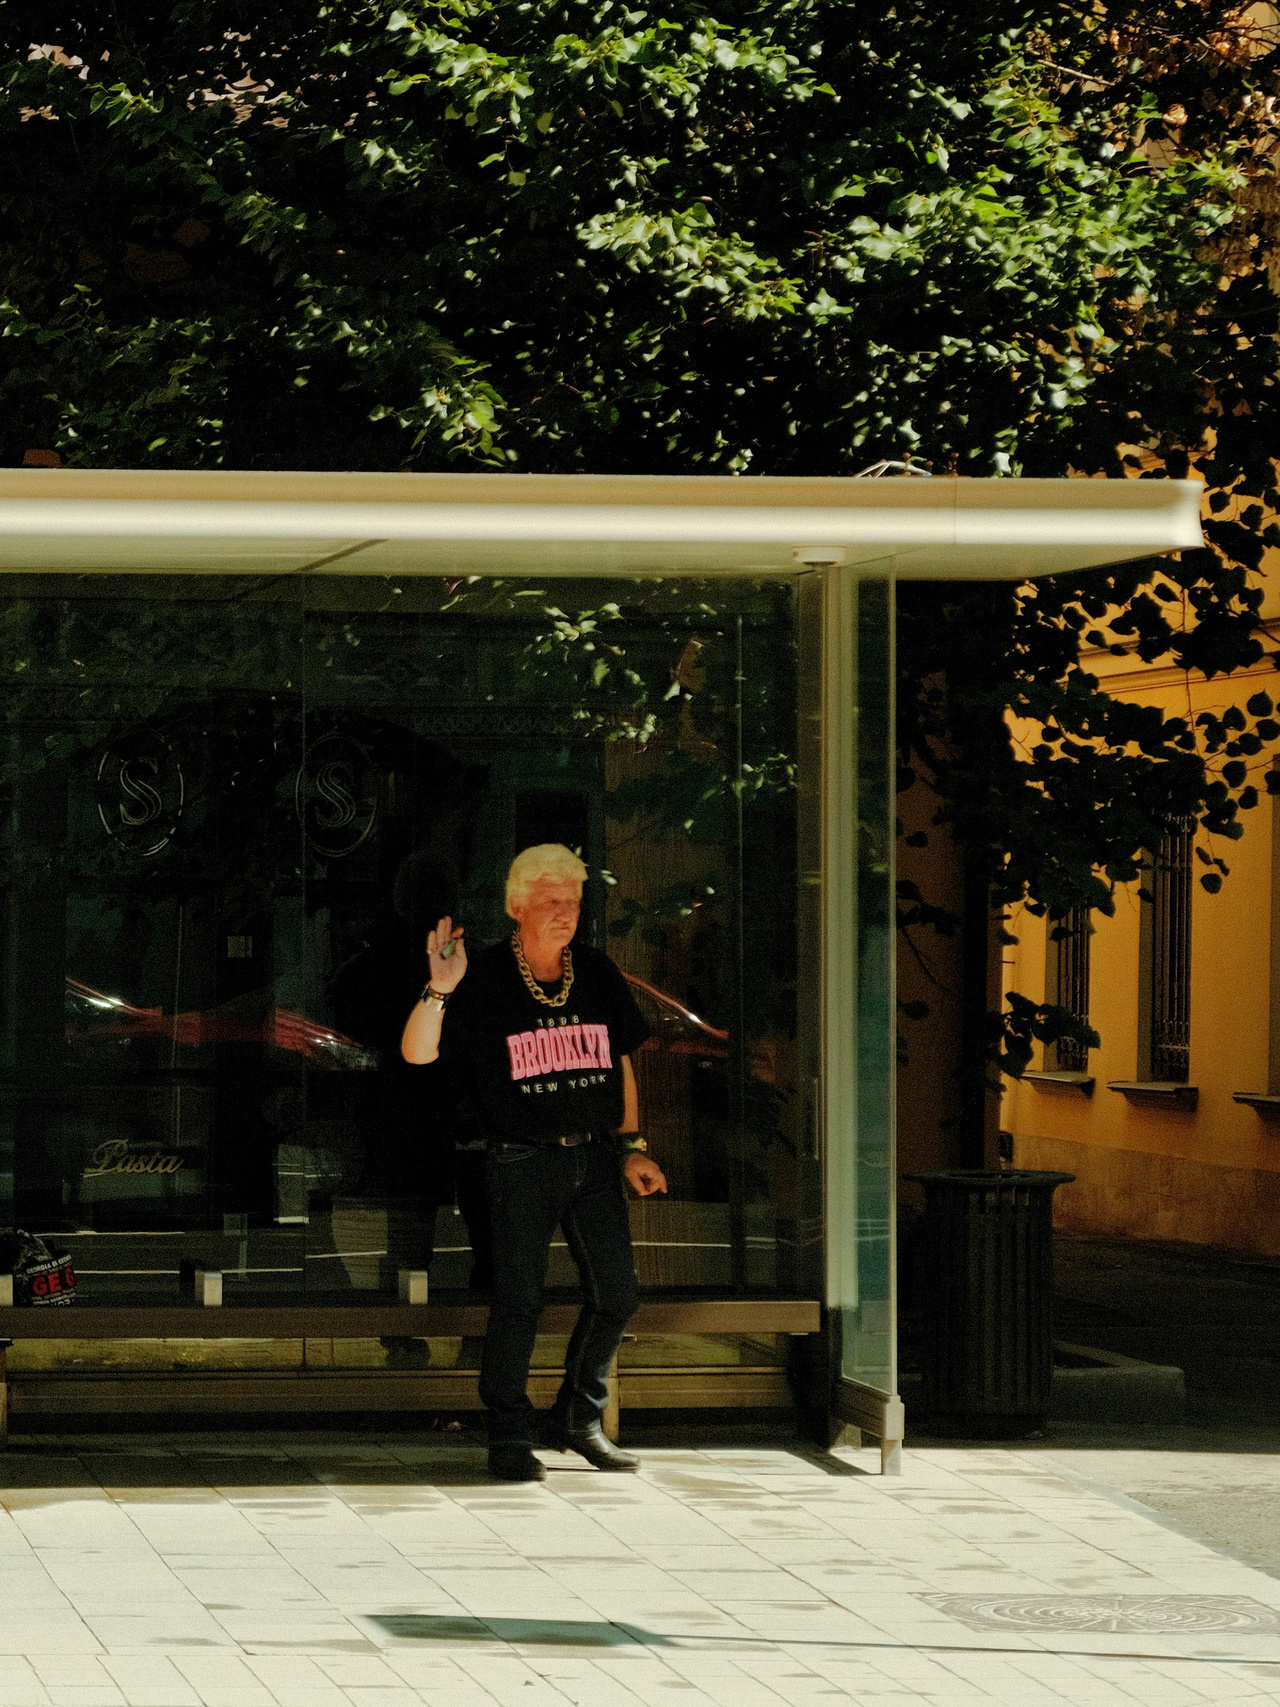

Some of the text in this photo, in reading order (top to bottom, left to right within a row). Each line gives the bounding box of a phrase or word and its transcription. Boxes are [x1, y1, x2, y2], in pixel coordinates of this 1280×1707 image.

[507, 1023, 613, 1081] BROOKLYN
[521, 1074, 607, 1094] NEW YORK
